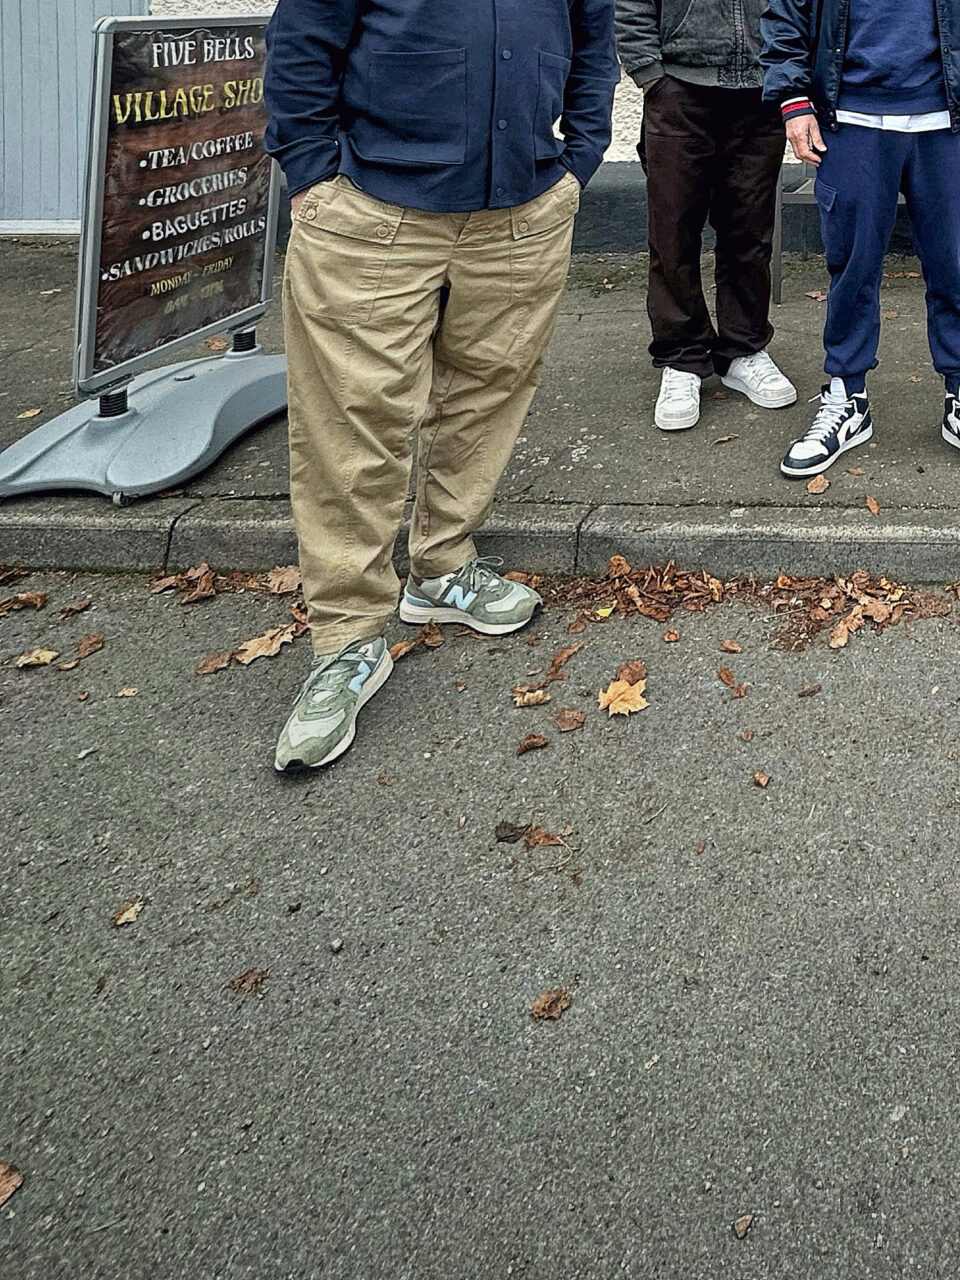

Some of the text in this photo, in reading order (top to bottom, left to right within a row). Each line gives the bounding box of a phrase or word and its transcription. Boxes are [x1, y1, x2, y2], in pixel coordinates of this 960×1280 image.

[152, 36, 255, 68] FIVE BELLS
[113, 78, 264, 124] VILLAGE SHO
[147, 167, 248, 207] GROCERIES
[151, 198, 247, 241] BAGUETTES
[150, 270, 193, 296] MONDAY
[202, 255, 234, 277] FRIDAY
